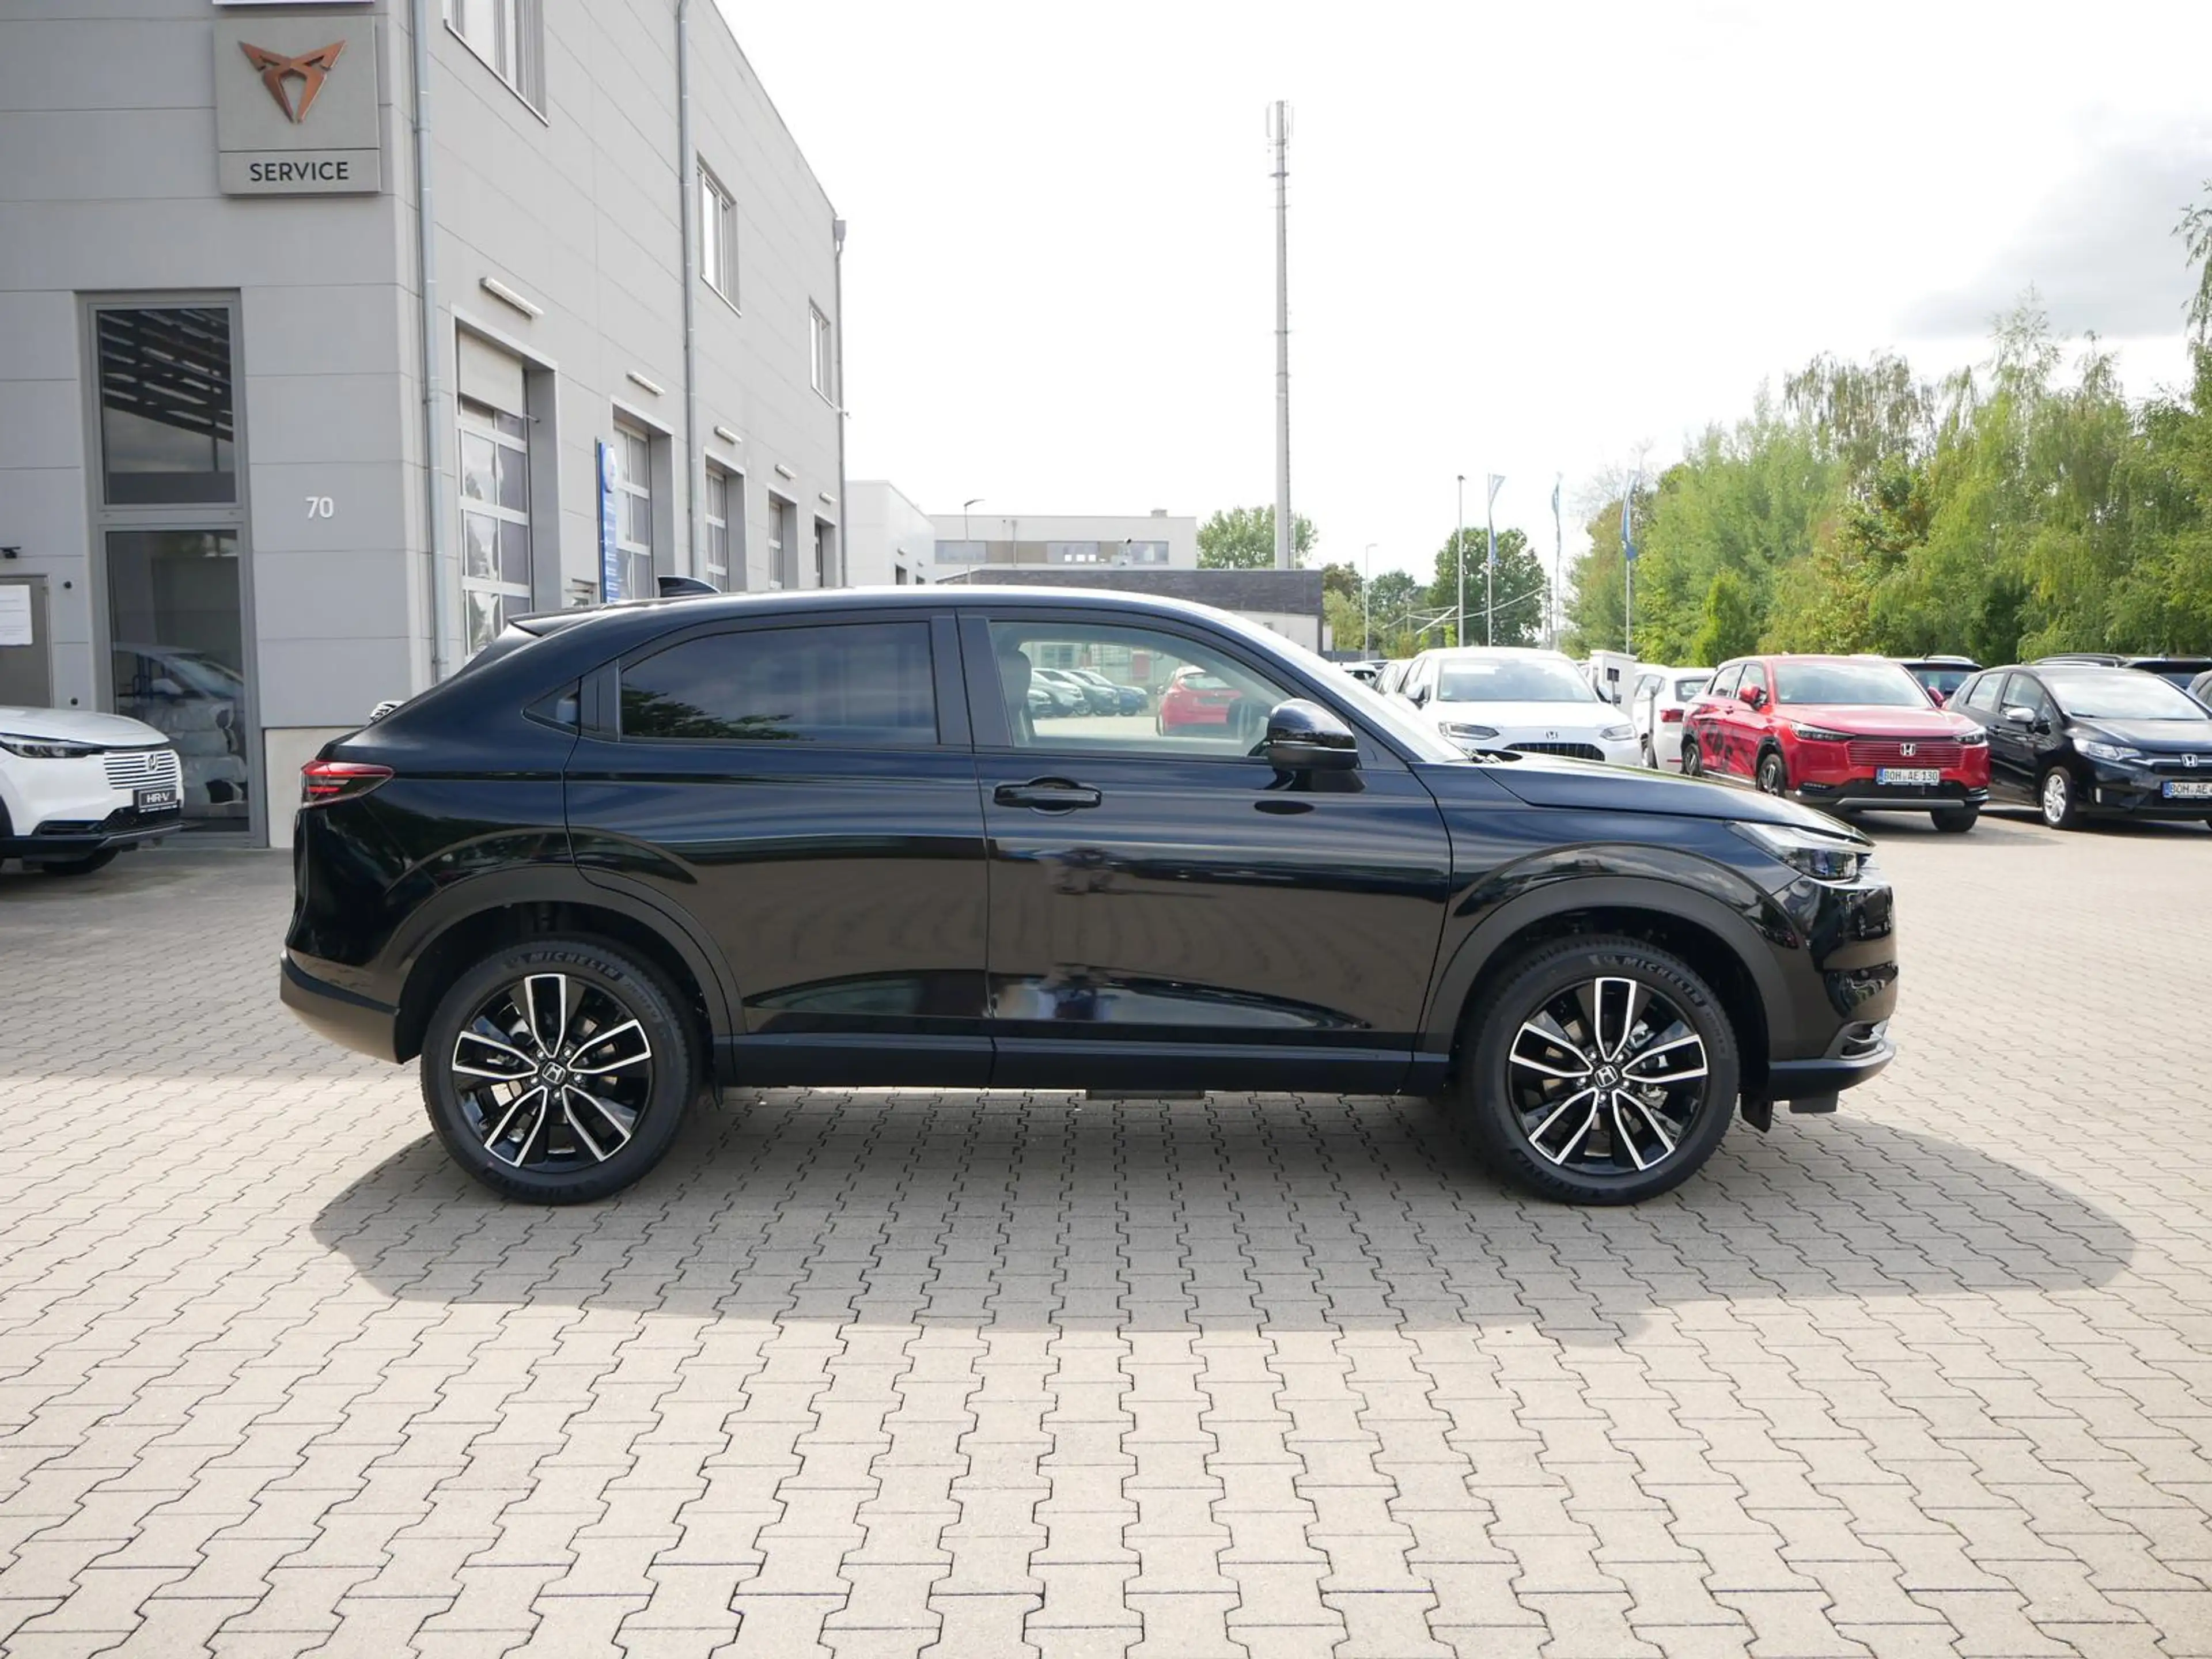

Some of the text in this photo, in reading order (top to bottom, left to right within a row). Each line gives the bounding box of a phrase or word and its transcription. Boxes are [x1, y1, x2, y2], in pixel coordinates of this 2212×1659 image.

[249, 161, 350, 182] SERVICE
[305, 497, 334, 518] 70
[1884, 771, 1902, 781] BOH
[1908, 771, 1919, 781] AE
[146, 791, 170, 803] HR-V
[529, 952, 620, 978] MICHELIN
[1623, 956, 1706, 1005] MICHELIN
